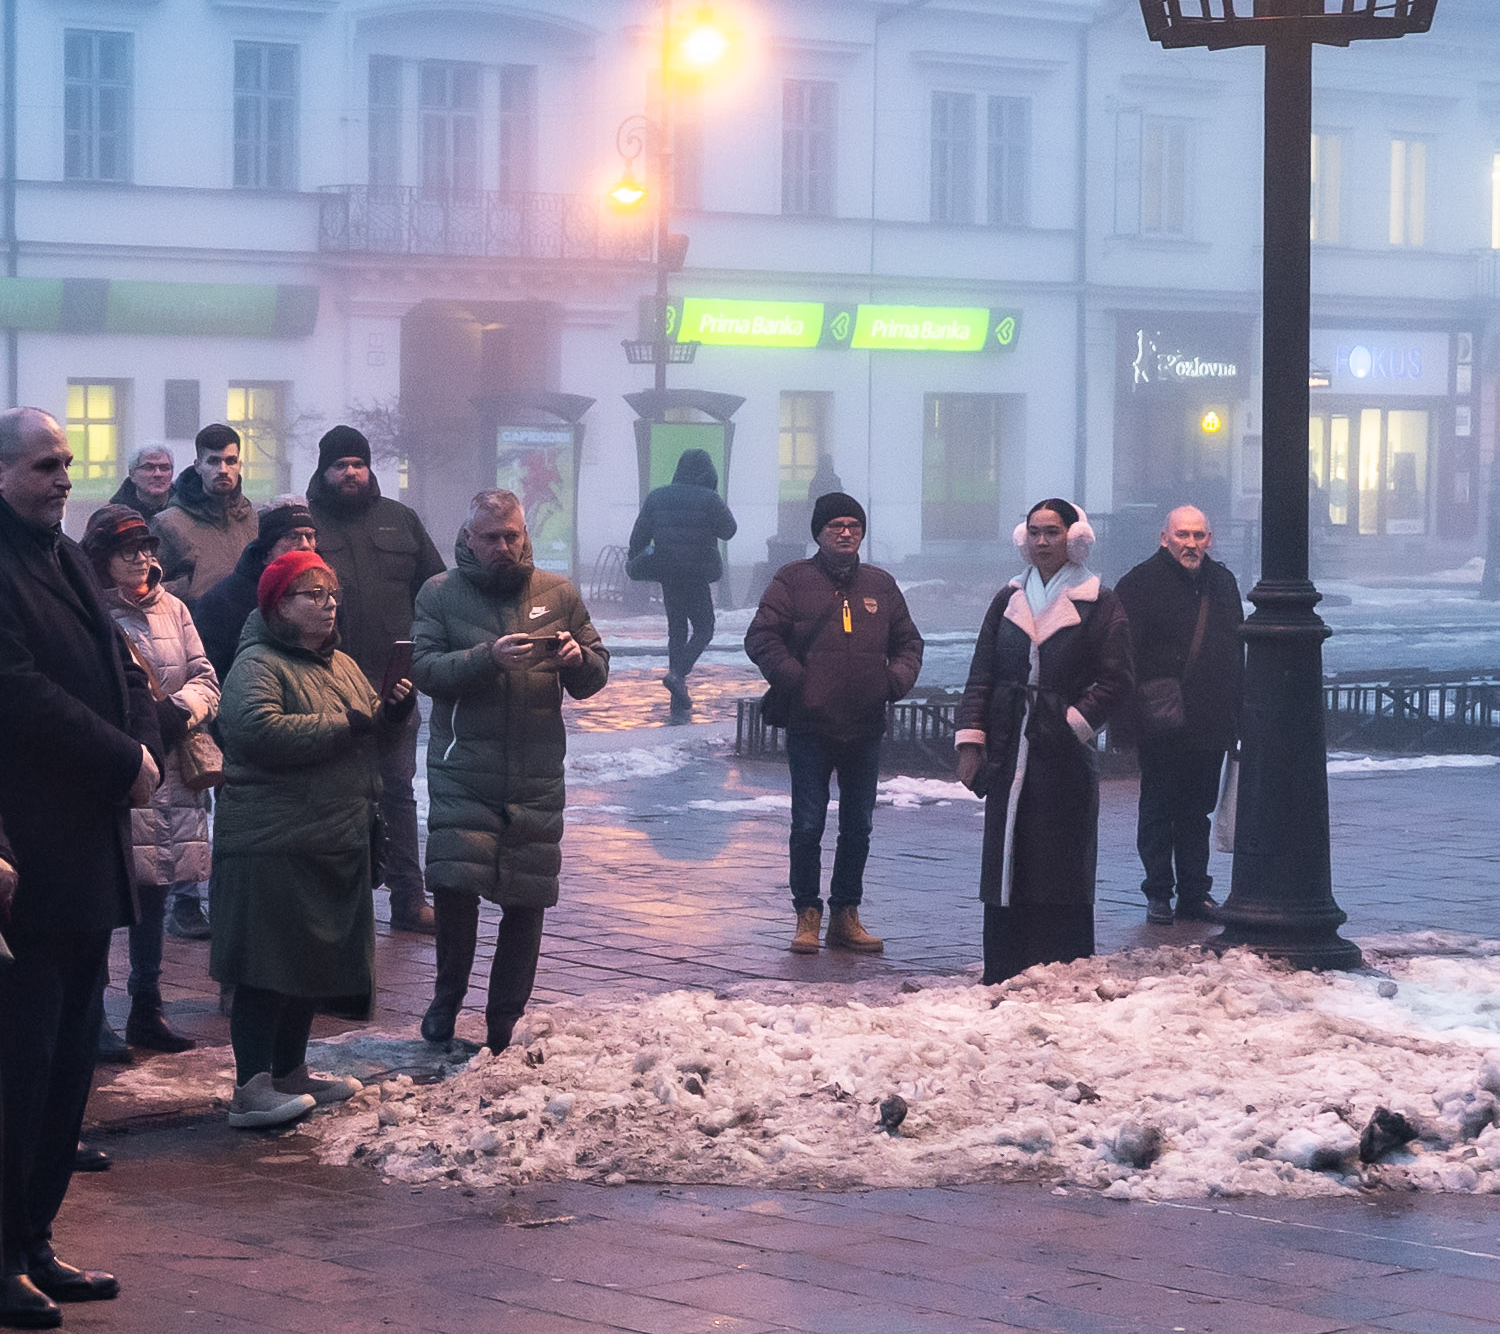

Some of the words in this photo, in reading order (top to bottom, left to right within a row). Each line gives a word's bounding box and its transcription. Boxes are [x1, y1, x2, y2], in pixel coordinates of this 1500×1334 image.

[699, 312, 750, 335] Prima
[752, 314, 805, 336] Banka
[871, 319, 919, 339] Prima
[920, 320, 971, 340] Banka
[1335, 344, 1424, 380] FOKUS
